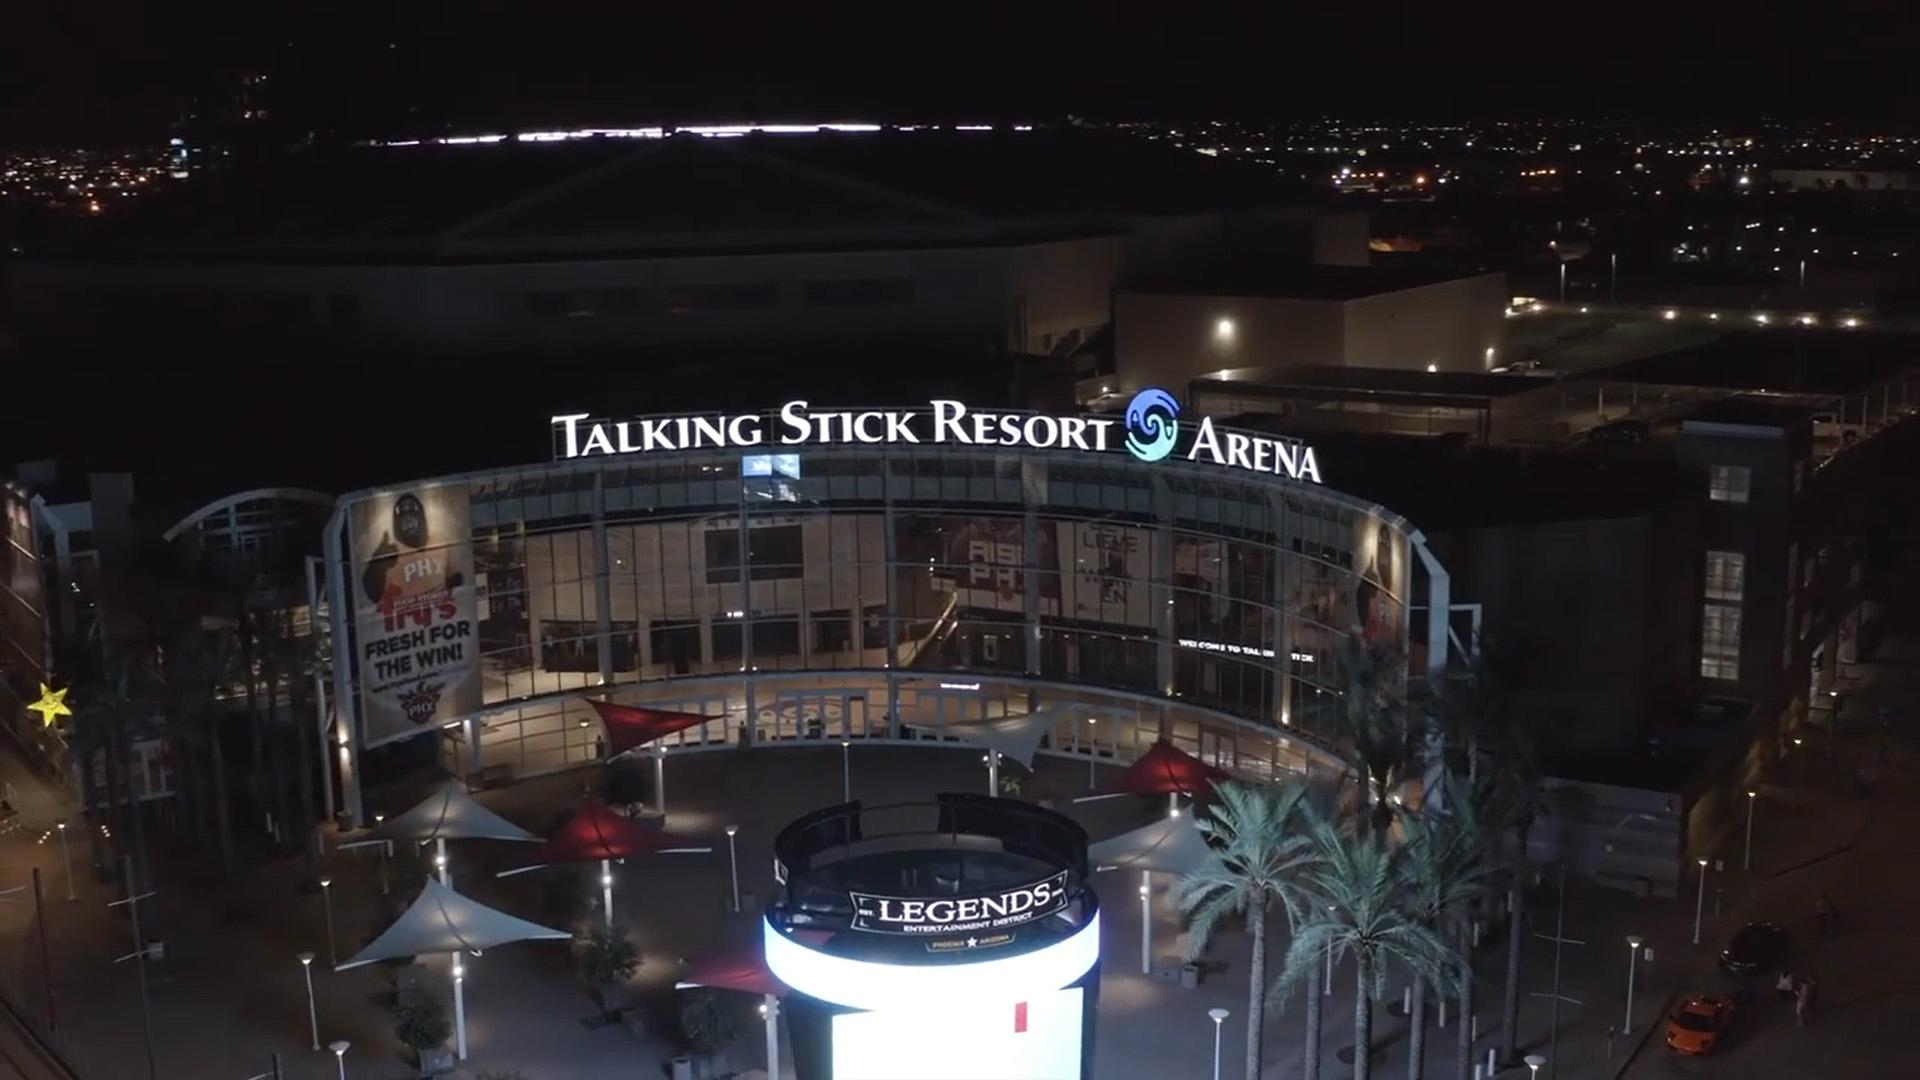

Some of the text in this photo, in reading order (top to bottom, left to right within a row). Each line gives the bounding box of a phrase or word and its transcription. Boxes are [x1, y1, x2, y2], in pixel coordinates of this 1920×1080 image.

[551, 395, 1322, 484] TALKING STICK RESORT ARENA
[365, 620, 470, 660] FRESH FOR
[1227, 644, 1242, 654] TO
[375, 643, 463, 679] THE WIN!
[879, 883, 1051, 923] LEGENDS
[903, 911, 1034, 933] ENTERTAINMENT DISTRICT
